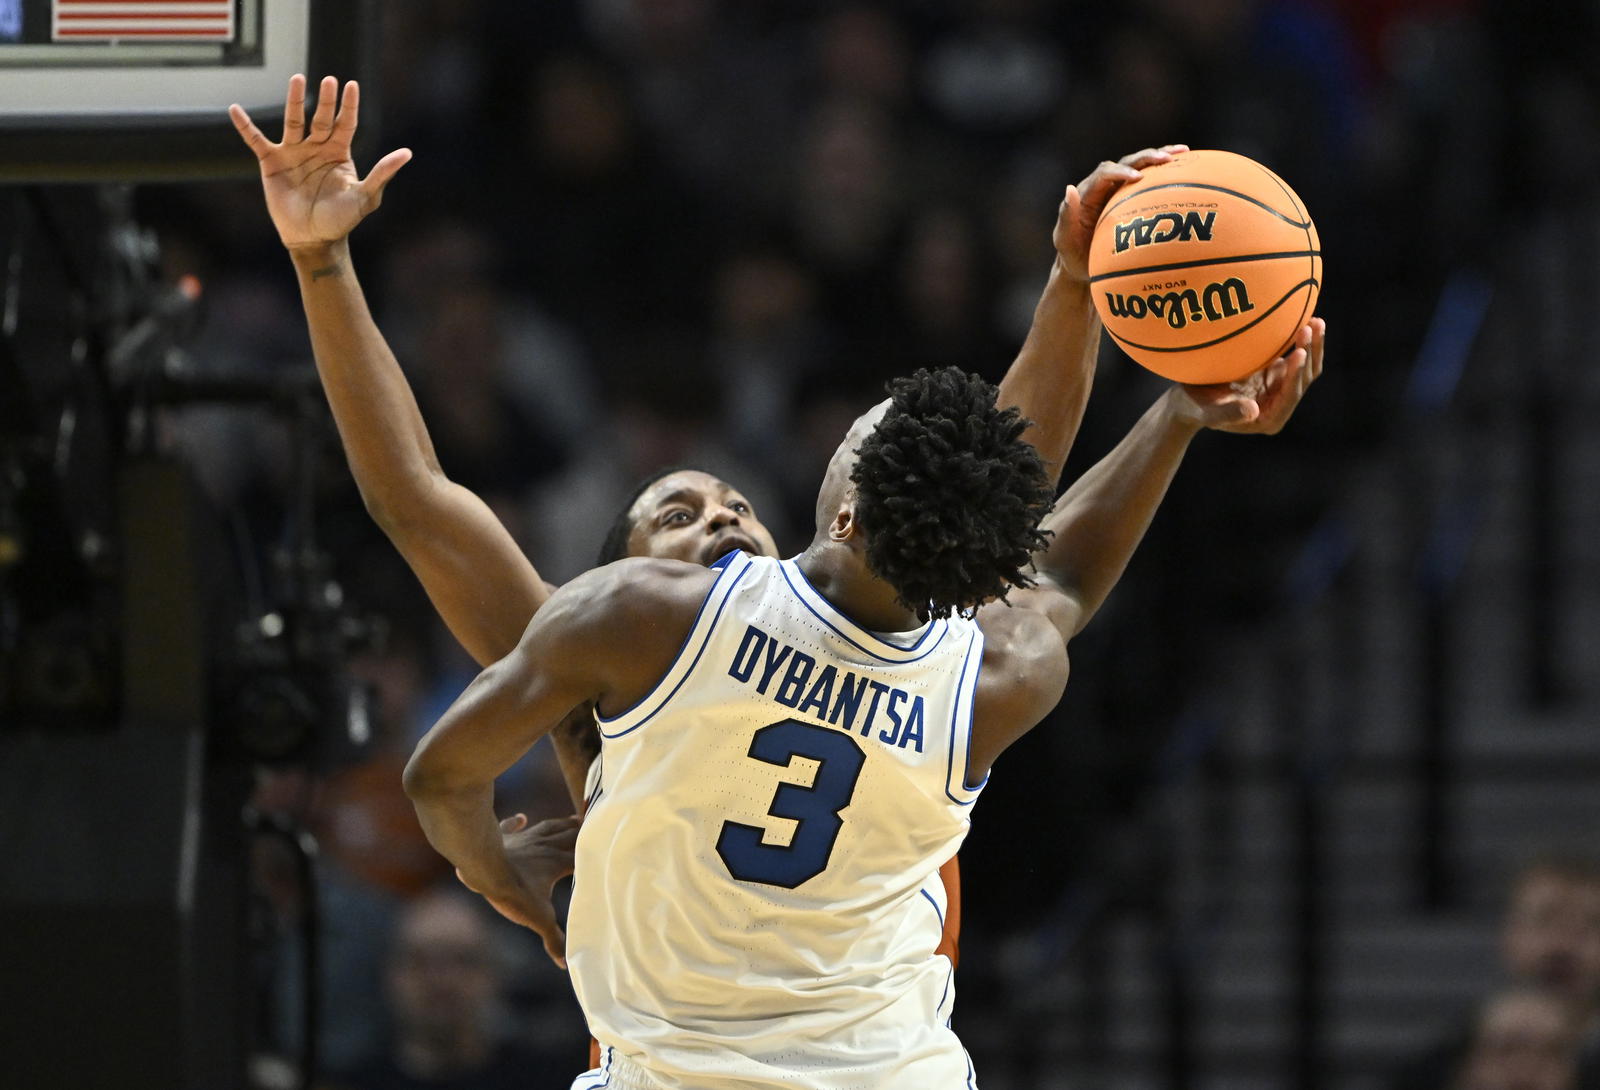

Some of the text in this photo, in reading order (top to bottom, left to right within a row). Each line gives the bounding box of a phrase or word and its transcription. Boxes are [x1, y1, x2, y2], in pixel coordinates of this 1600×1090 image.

[1141, 203, 1169, 212] GAME
[1114, 211, 1217, 254] NCAA
[1105, 277, 1255, 330] Wilson
[1142, 279, 1188, 292] EVO NXT
[727, 624, 924, 753] DYBANTSA
[715, 717, 867, 889] 3
